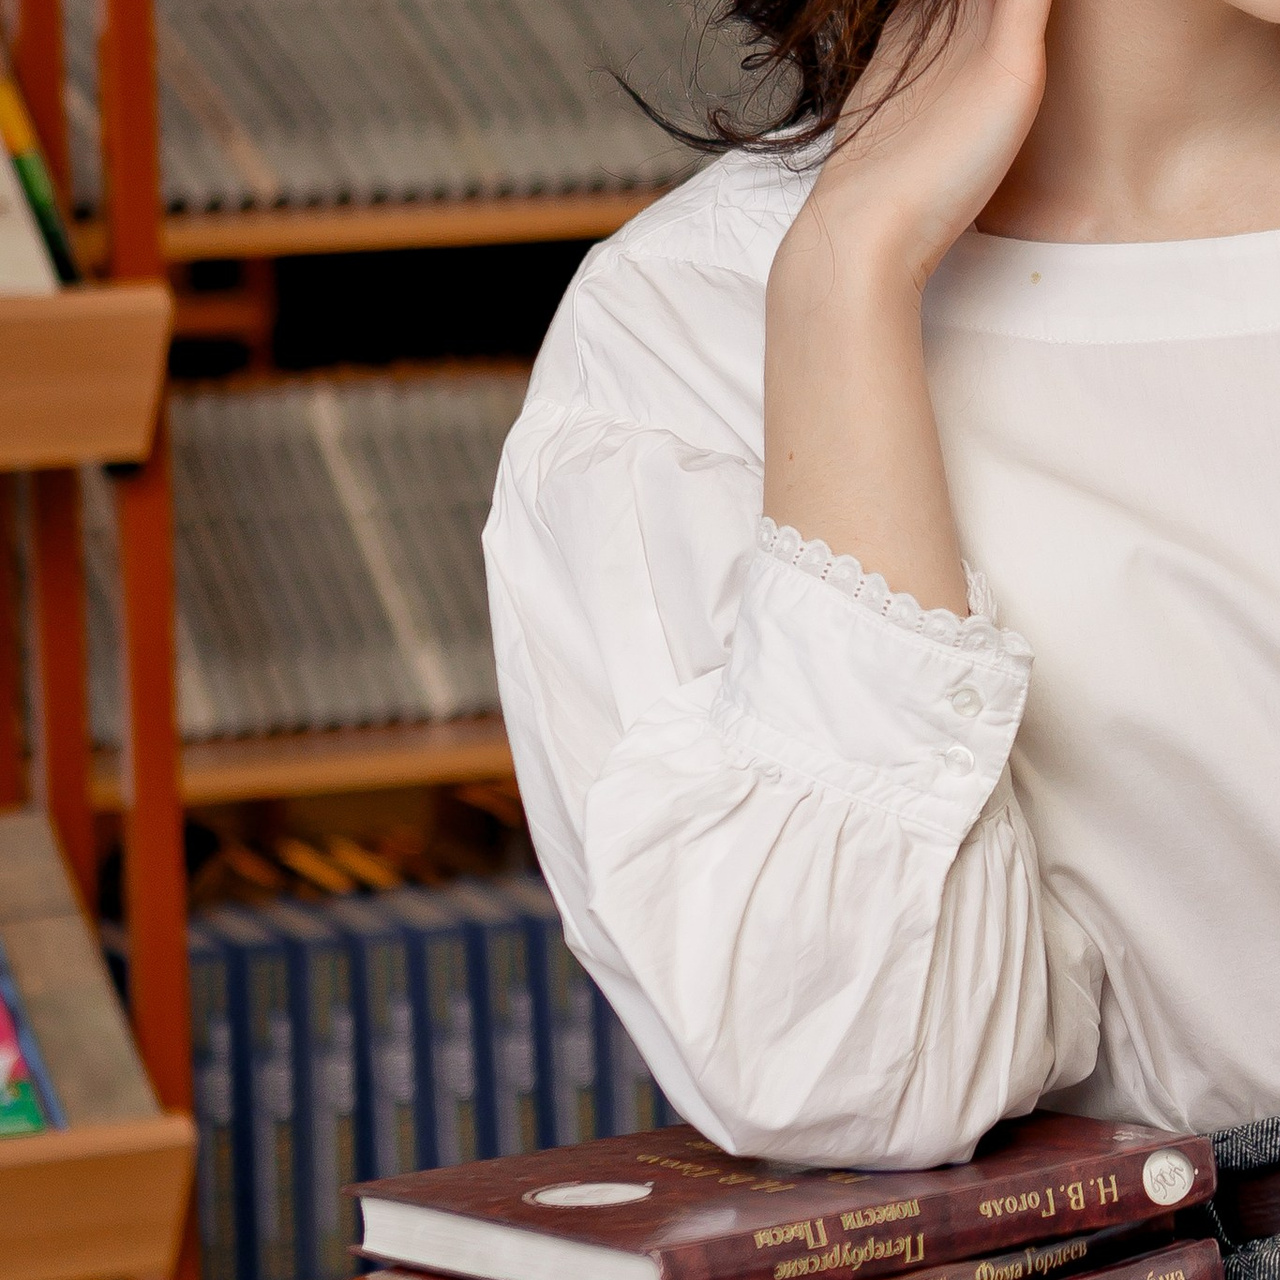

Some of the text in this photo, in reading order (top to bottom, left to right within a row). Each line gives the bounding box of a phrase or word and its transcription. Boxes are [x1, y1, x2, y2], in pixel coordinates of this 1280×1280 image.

[979, 1174, 1119, 1219] Н. В. Гоголь
[753, 1199, 921, 1250] повести Пьесы
[774, 1232, 925, 1280] Петербургские
[1026, 1239, 1089, 1276] Гордеев
